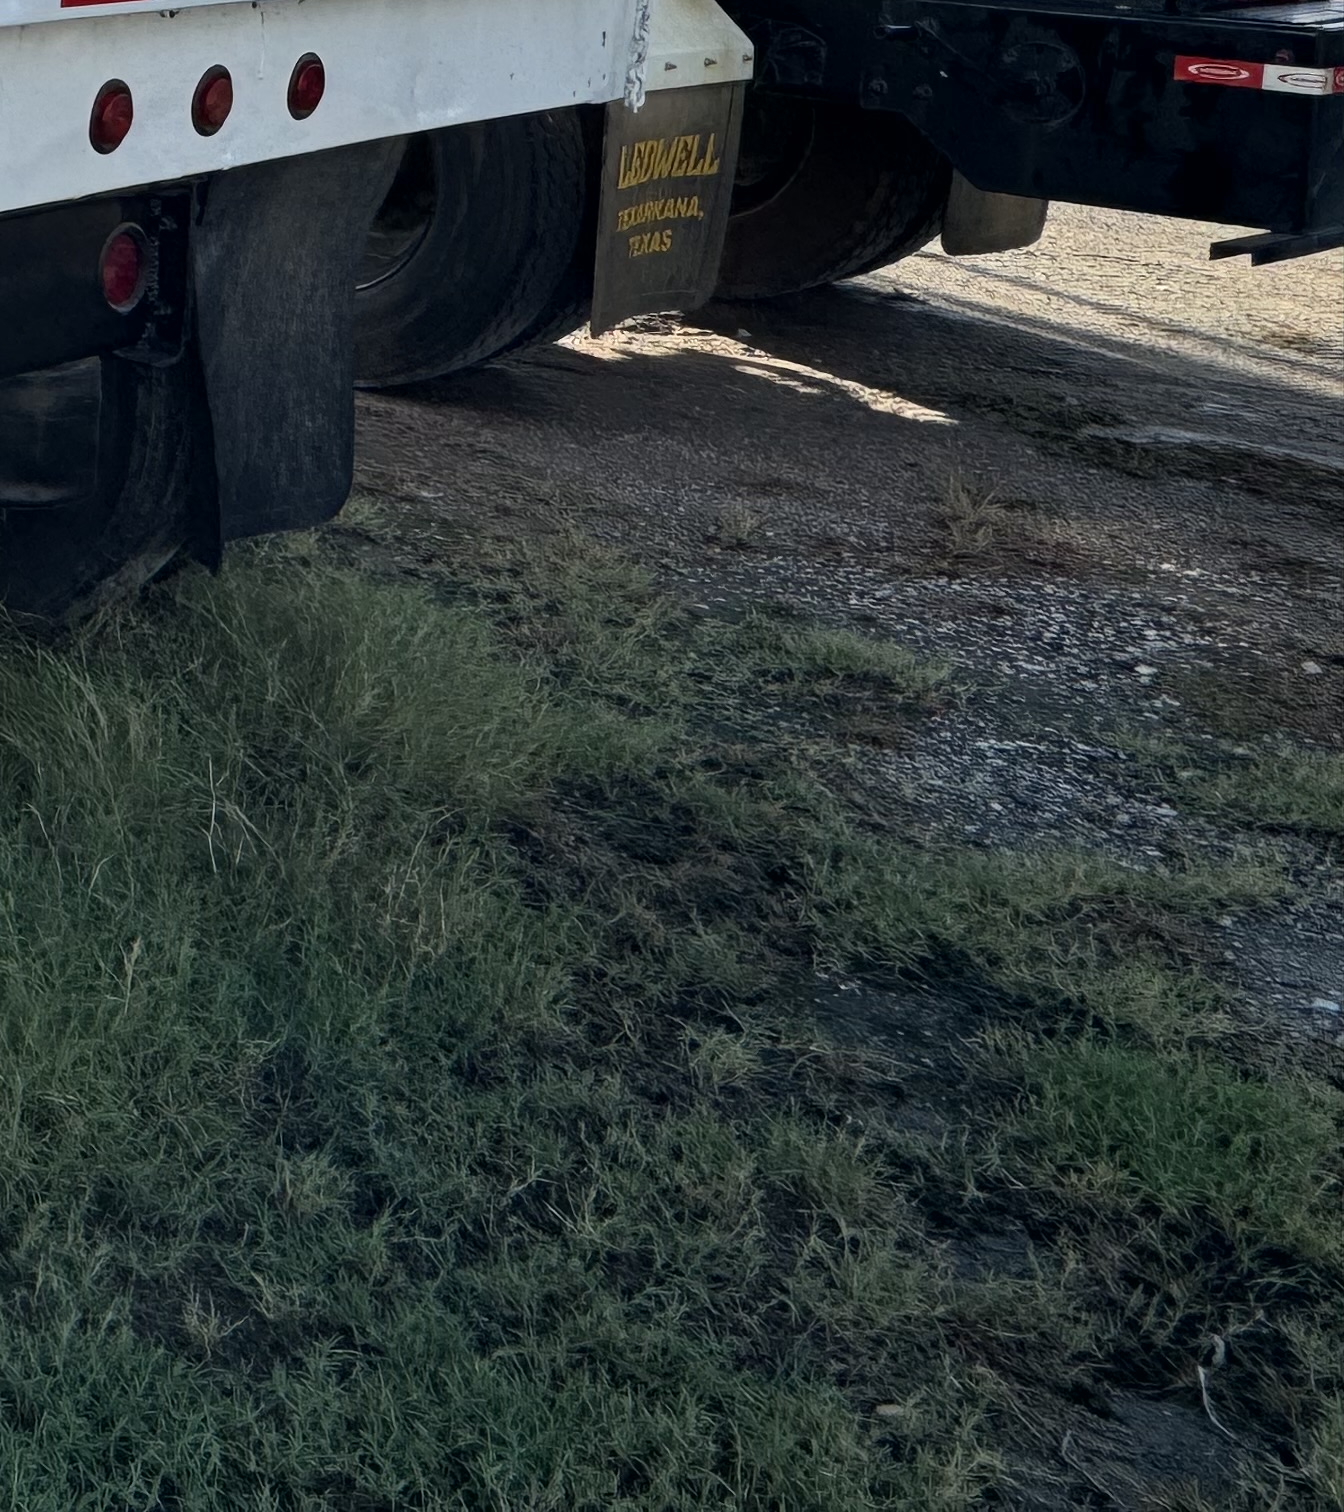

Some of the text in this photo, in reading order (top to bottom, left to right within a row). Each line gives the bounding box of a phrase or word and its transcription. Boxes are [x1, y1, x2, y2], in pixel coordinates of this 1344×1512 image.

[616, 132, 720, 189] LEDWELL
[616, 195, 704, 232] TEXARKANA,
[628, 229, 672, 258] TEXAS
